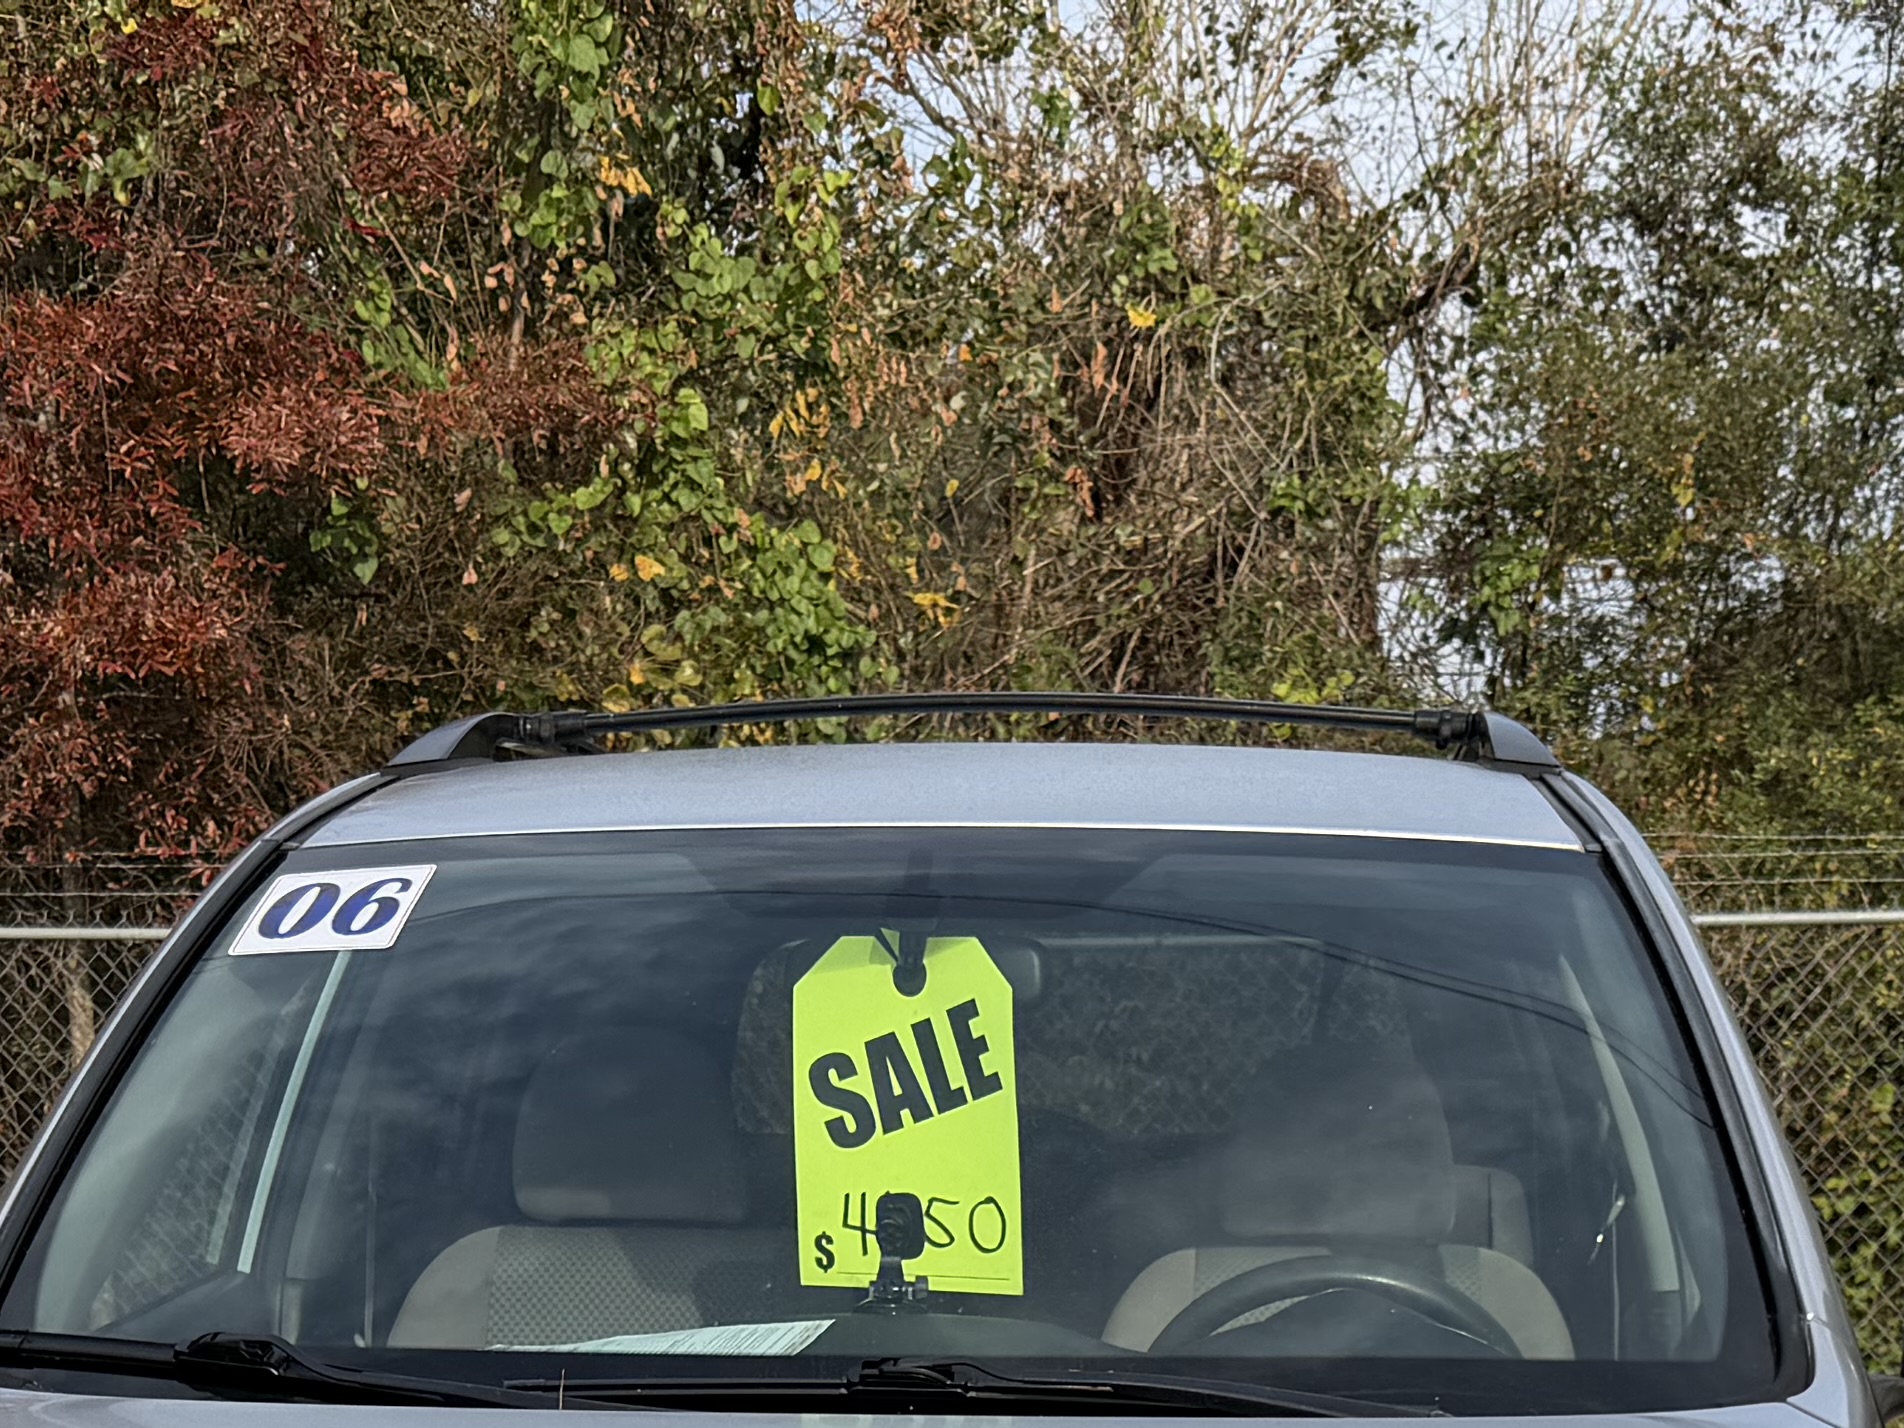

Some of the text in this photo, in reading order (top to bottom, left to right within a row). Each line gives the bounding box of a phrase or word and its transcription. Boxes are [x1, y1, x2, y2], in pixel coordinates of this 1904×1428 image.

[258, 877, 413, 940] 06
[808, 998, 1003, 1149] SALE
[814, 1191, 1007, 1273] $450
